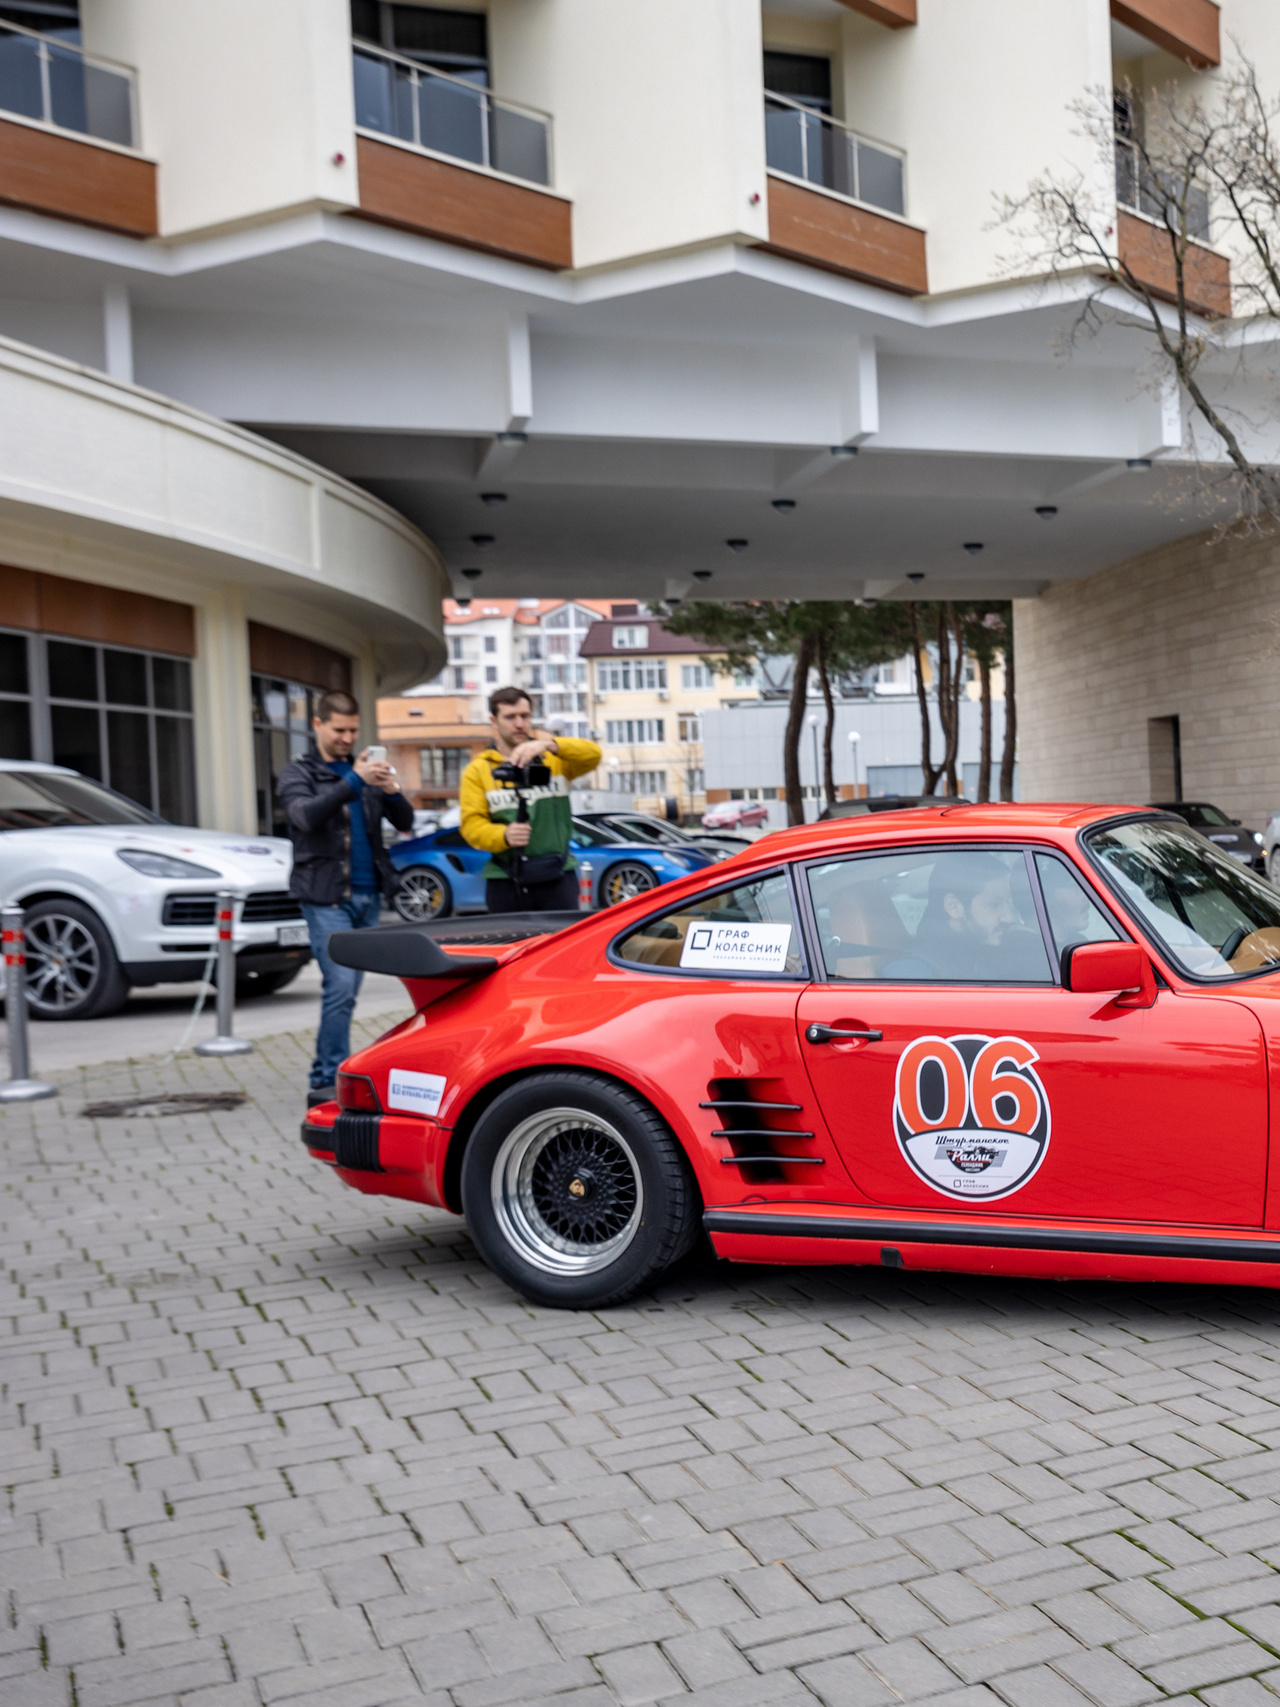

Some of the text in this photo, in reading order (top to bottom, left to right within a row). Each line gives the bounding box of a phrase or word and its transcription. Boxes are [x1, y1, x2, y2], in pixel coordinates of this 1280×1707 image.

[718, 930, 750, 938] ГРАФ
[715, 943, 782, 953] КОЛЕСНИК
[896, 1035, 1041, 1135] 06
[935, 1136, 1009, 1147] Штурманское
[952, 1149, 991, 1161] Ралли
